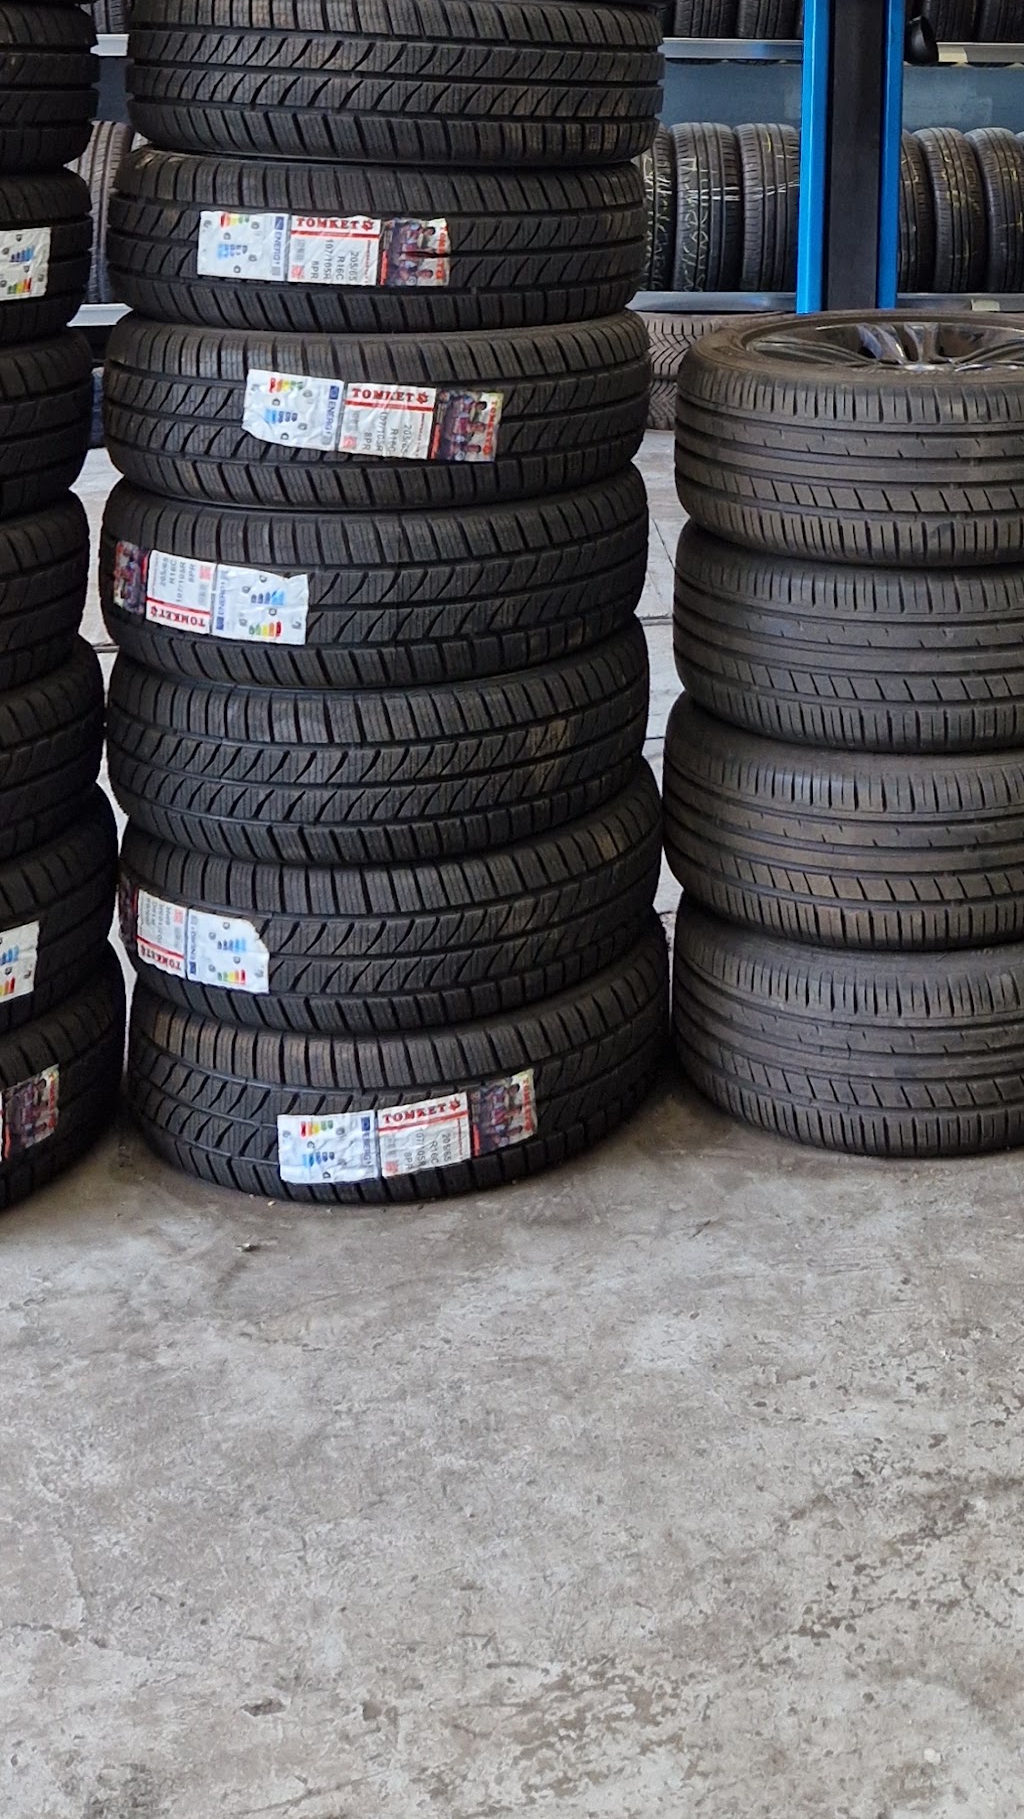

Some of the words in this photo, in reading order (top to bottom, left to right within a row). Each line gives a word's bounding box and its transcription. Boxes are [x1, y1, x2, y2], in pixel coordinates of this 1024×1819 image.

[296, 217, 358, 230] TOMKET
[352, 387, 415, 402] TOMKET
[158, 608, 206, 627] TOMKET
[383, 1102, 447, 1124] TOMKET
